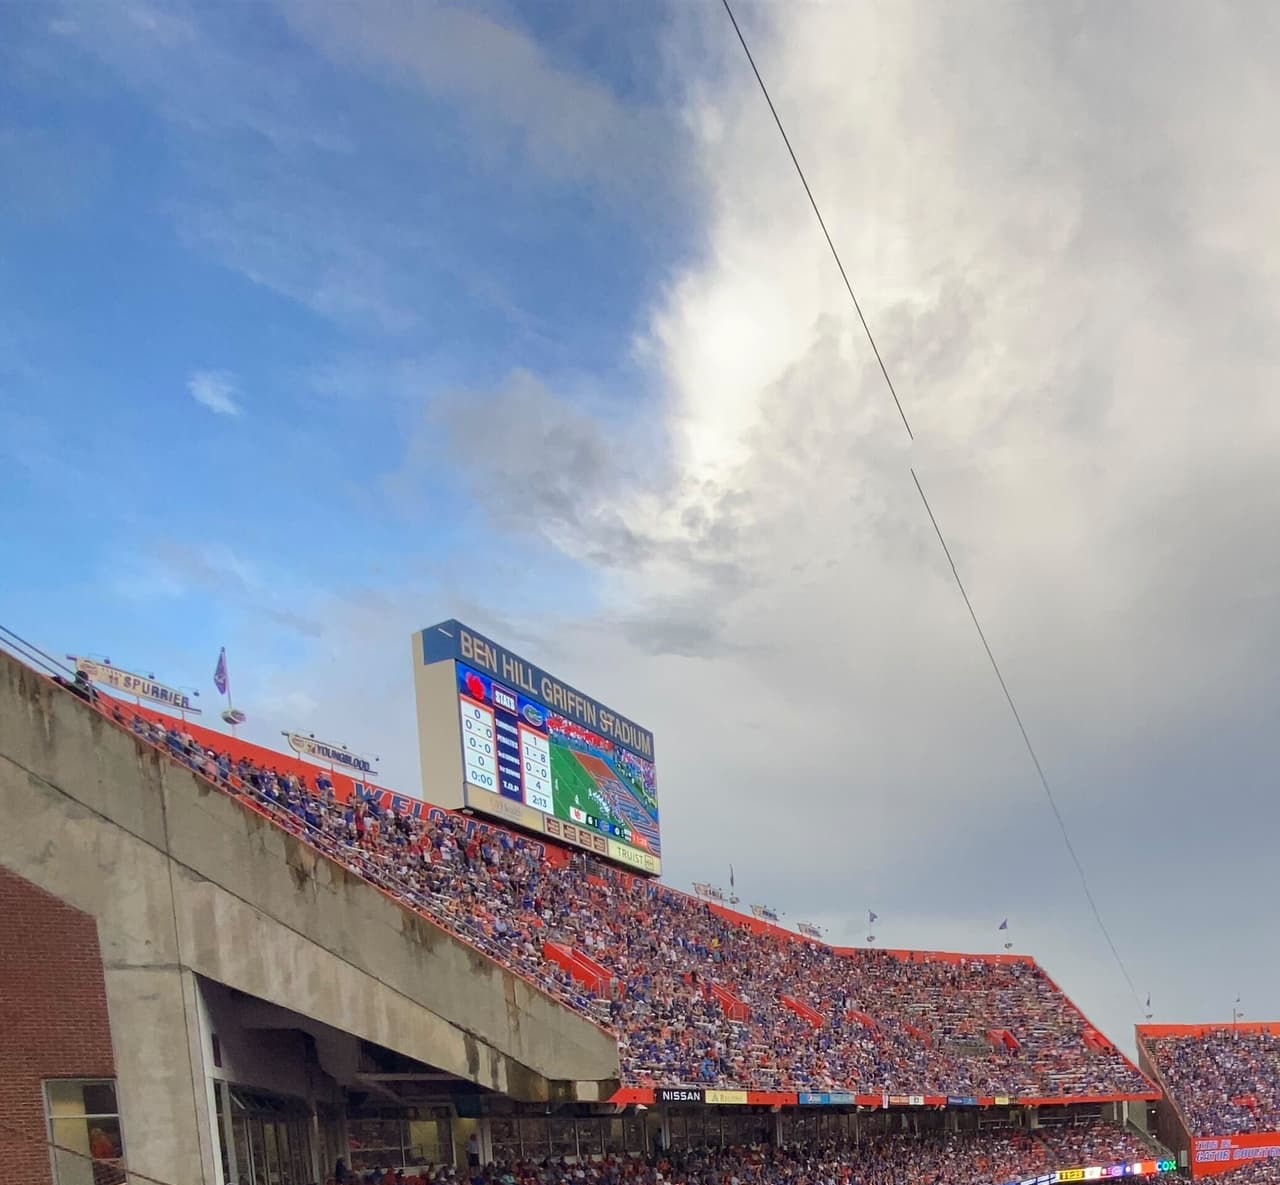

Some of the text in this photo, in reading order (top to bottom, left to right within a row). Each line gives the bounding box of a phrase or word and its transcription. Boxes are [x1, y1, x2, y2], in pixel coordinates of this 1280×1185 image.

[123, 675, 190, 709] SPURRIER
[460, 630, 651, 756] BEN HILL GRIFFIN STADIUM
[474, 709, 481, 719] 0
[316, 743, 371, 772] YOUNGBLOOD
[478, 756, 485, 766] 0
[471, 770, 493, 787] 0:00
[532, 795, 547, 808] 2:13
[617, 847, 644, 865] TRUIST
[662, 1090, 701, 1101] NISSAN
[1196, 1149, 1230, 1162] GATOR
[1157, 1160, 1177, 1172] COX
[1061, 1170, 1084, 1180] 11:23
